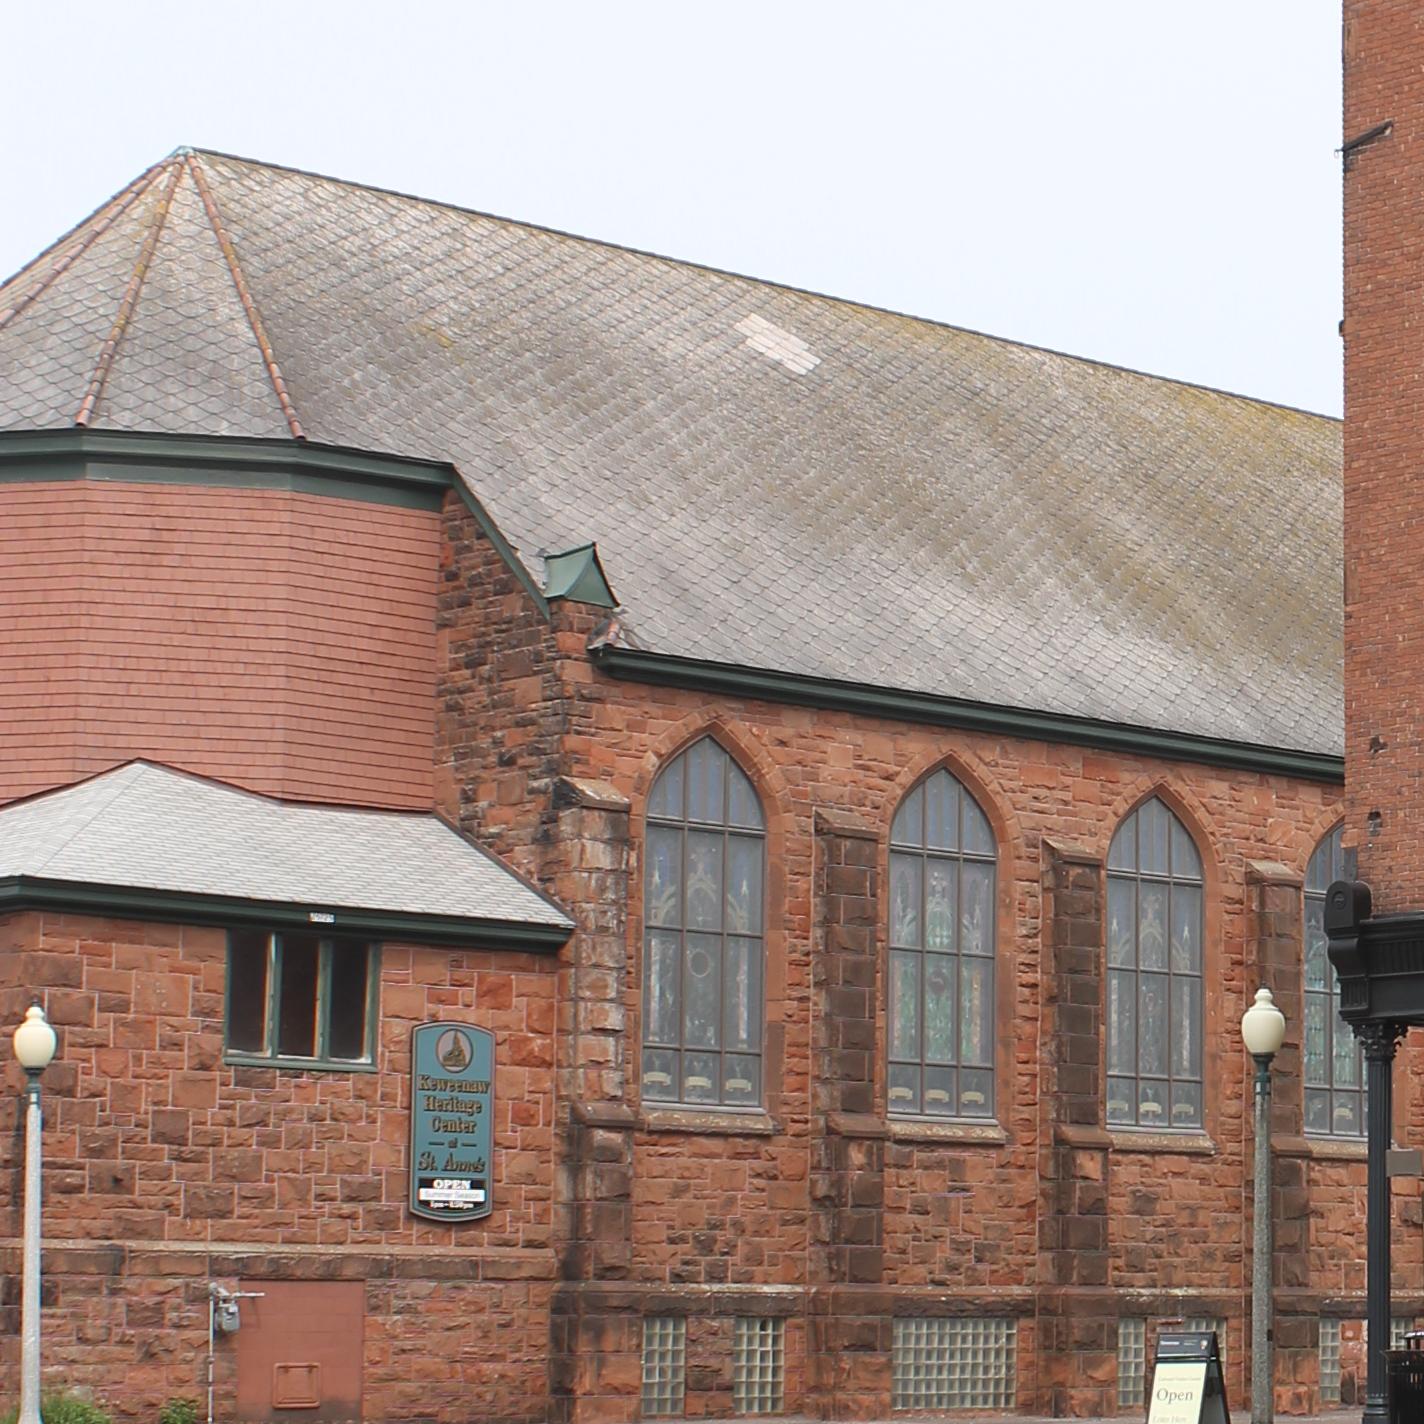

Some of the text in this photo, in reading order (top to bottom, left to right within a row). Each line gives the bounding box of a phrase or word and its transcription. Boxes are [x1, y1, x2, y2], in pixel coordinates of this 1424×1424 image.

[418, 1075, 489, 1093] Keweenaw
[424, 1096, 482, 1116] Heritage
[432, 1116, 476, 1133] Center
[418, 1152, 485, 1173] St. Anne's
[433, 1179, 471, 1189] OPEN
[1157, 1388, 1193, 1404] Open
